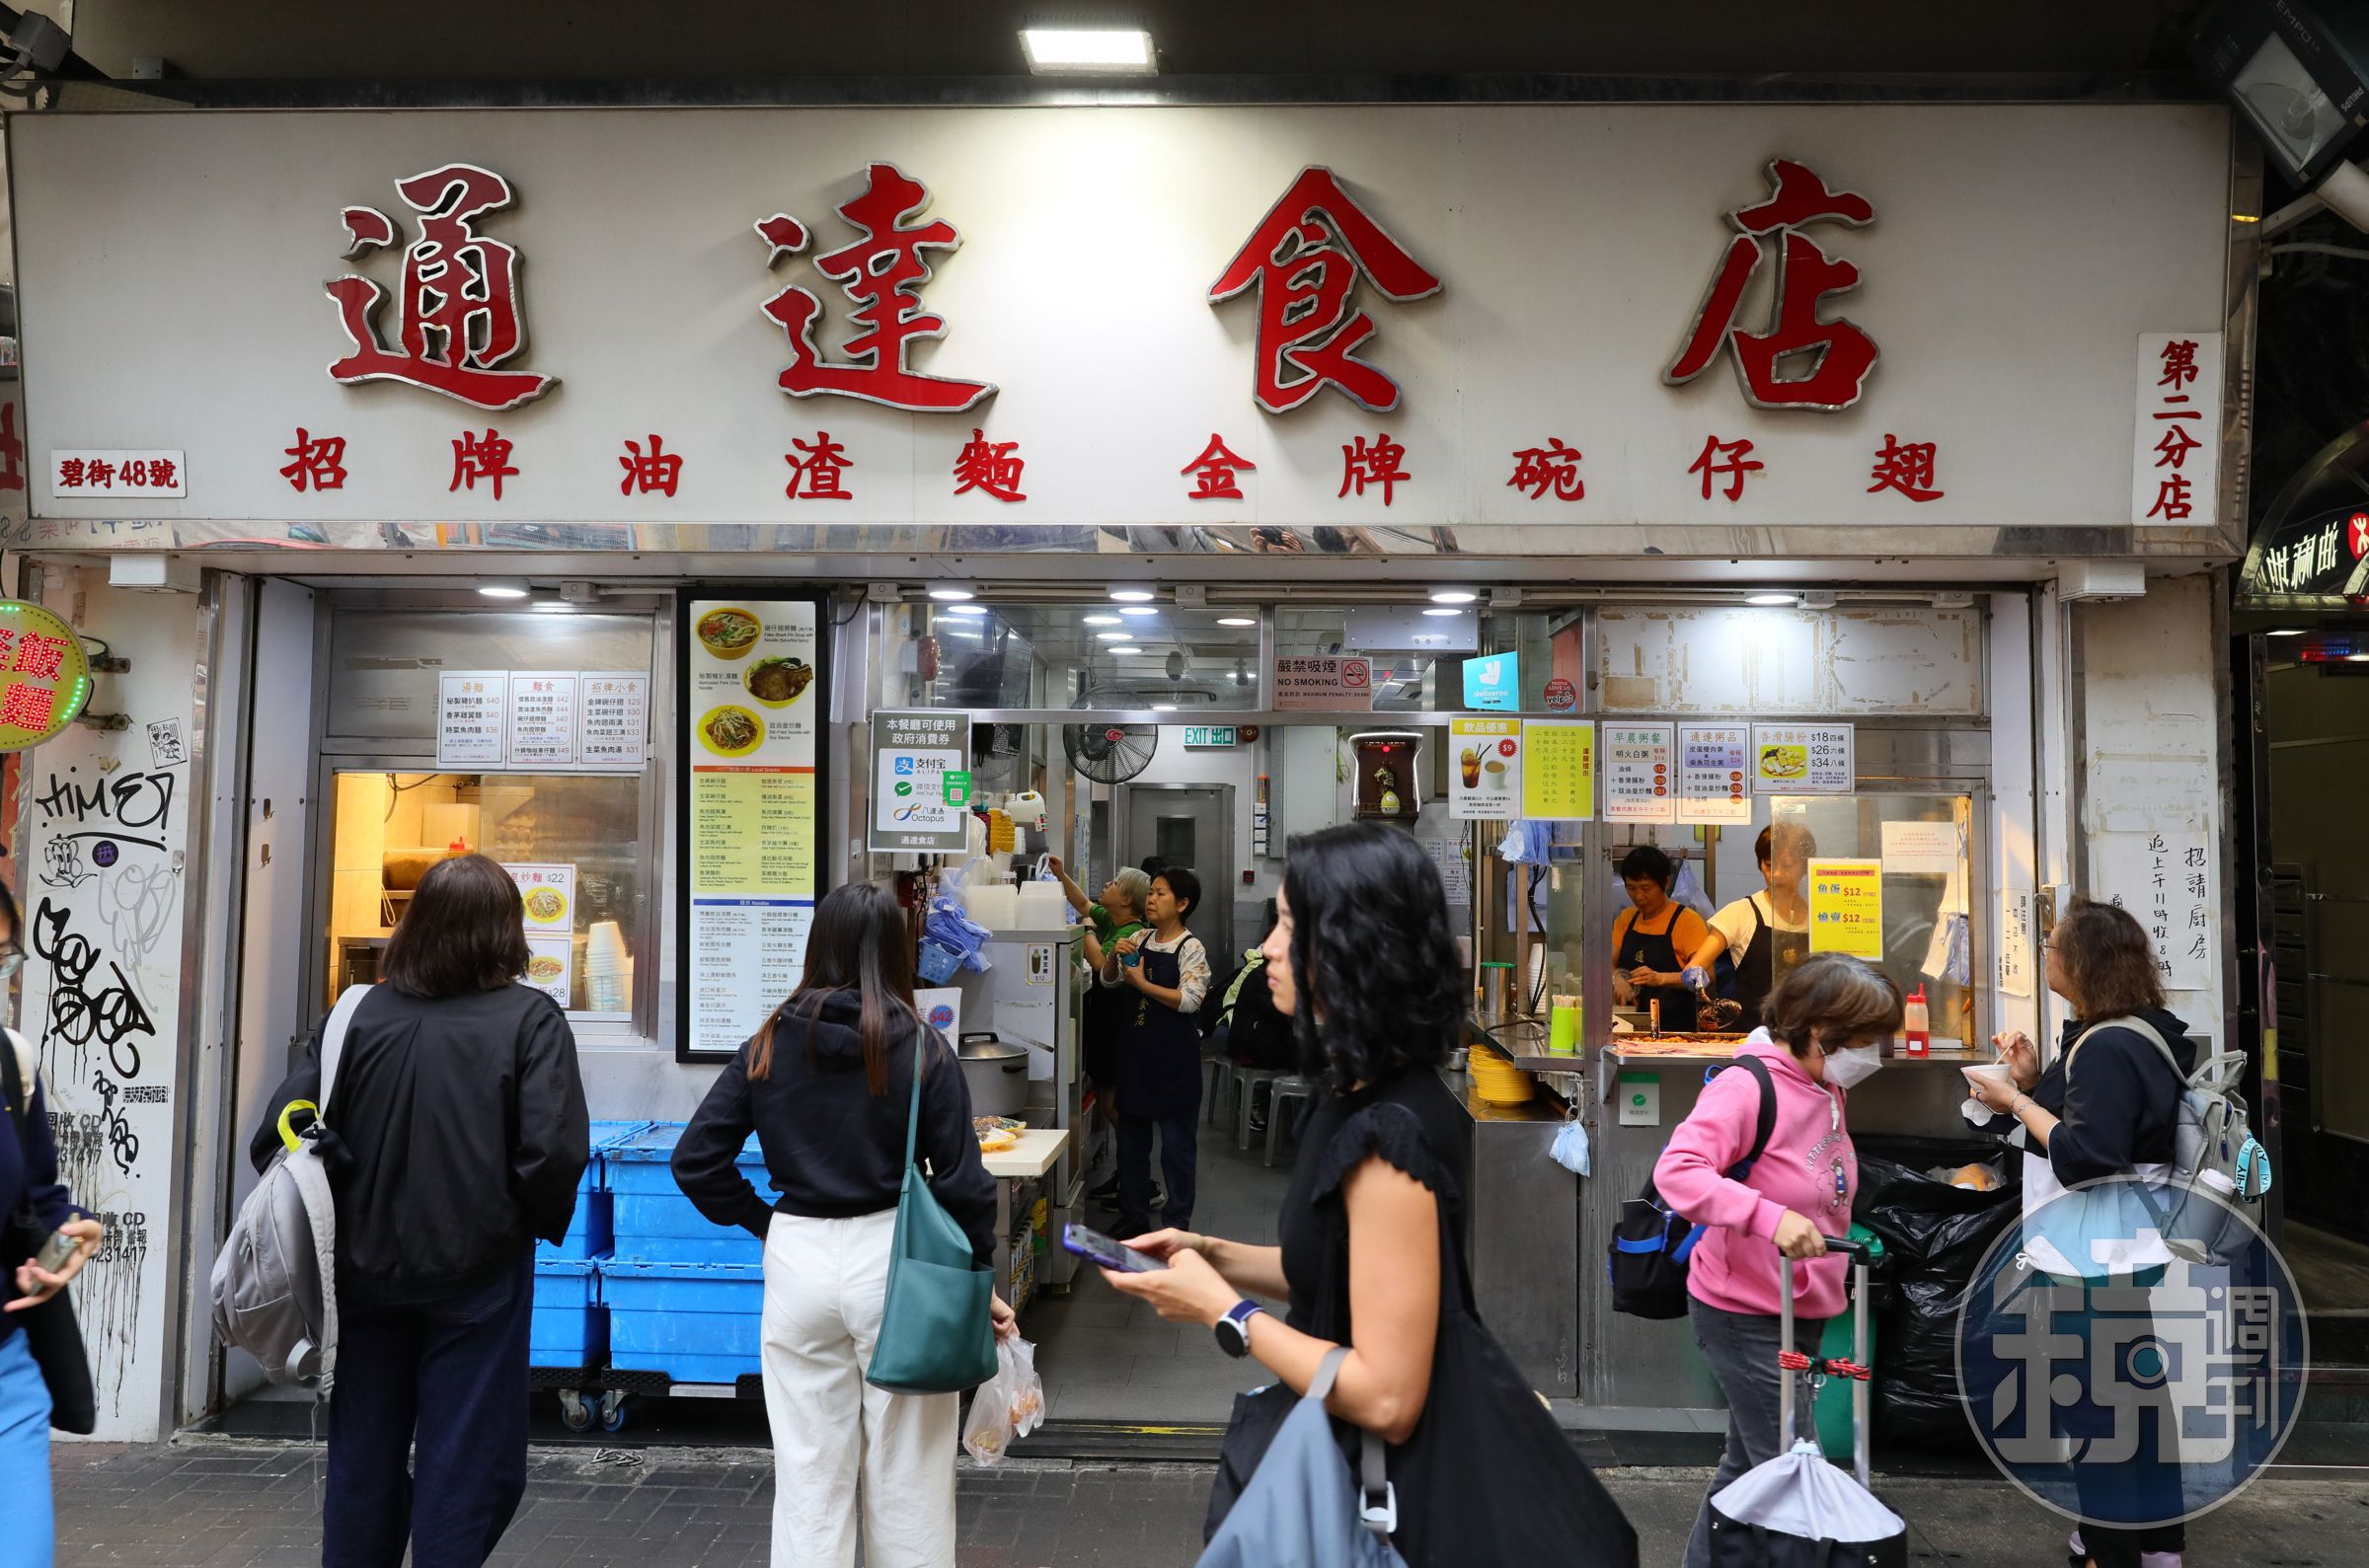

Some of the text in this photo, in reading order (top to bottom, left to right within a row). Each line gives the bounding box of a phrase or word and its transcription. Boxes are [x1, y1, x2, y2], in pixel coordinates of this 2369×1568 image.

[325, 156, 1880, 412] 通達食店
[2147, 339, 2202, 520] 第二分店
[279, 427, 1945, 506] 招牌油渣麵 金牌碗仔翅
[59, 458, 179, 489] 碧街48號
[0, 629, 69, 681] 飯
[1277, 660, 1337, 673] 嚴禁吸煙
[1547, 695, 1566, 705] yelp
[886, 718, 955, 731] 本餐廳可使用
[1464, 722, 1508, 733] 飲品優惠
[891, 733, 950, 745] 政府消費券
[1185, 727, 1234, 744] EXIT 出口
[1614, 732, 1661, 744] 早晨粥餐
[1690, 731, 1736, 743] 通達粥品
[1810, 732, 1829, 742] $18
[1616, 750, 1649, 759] 明火白粥
[1811, 745, 1829, 755] $26
[916, 759, 946, 769] 支付宝
[1811, 758, 1829, 767] $34
[547, 873, 565, 883] $22
[1843, 887, 1861, 897] $12
[1843, 914, 1860, 924] $12
[548, 988, 566, 998] $28
[80, 1114, 102, 1127] CD
[56, 1148, 102, 1165] 31417
[122, 1212, 145, 1226] CD
